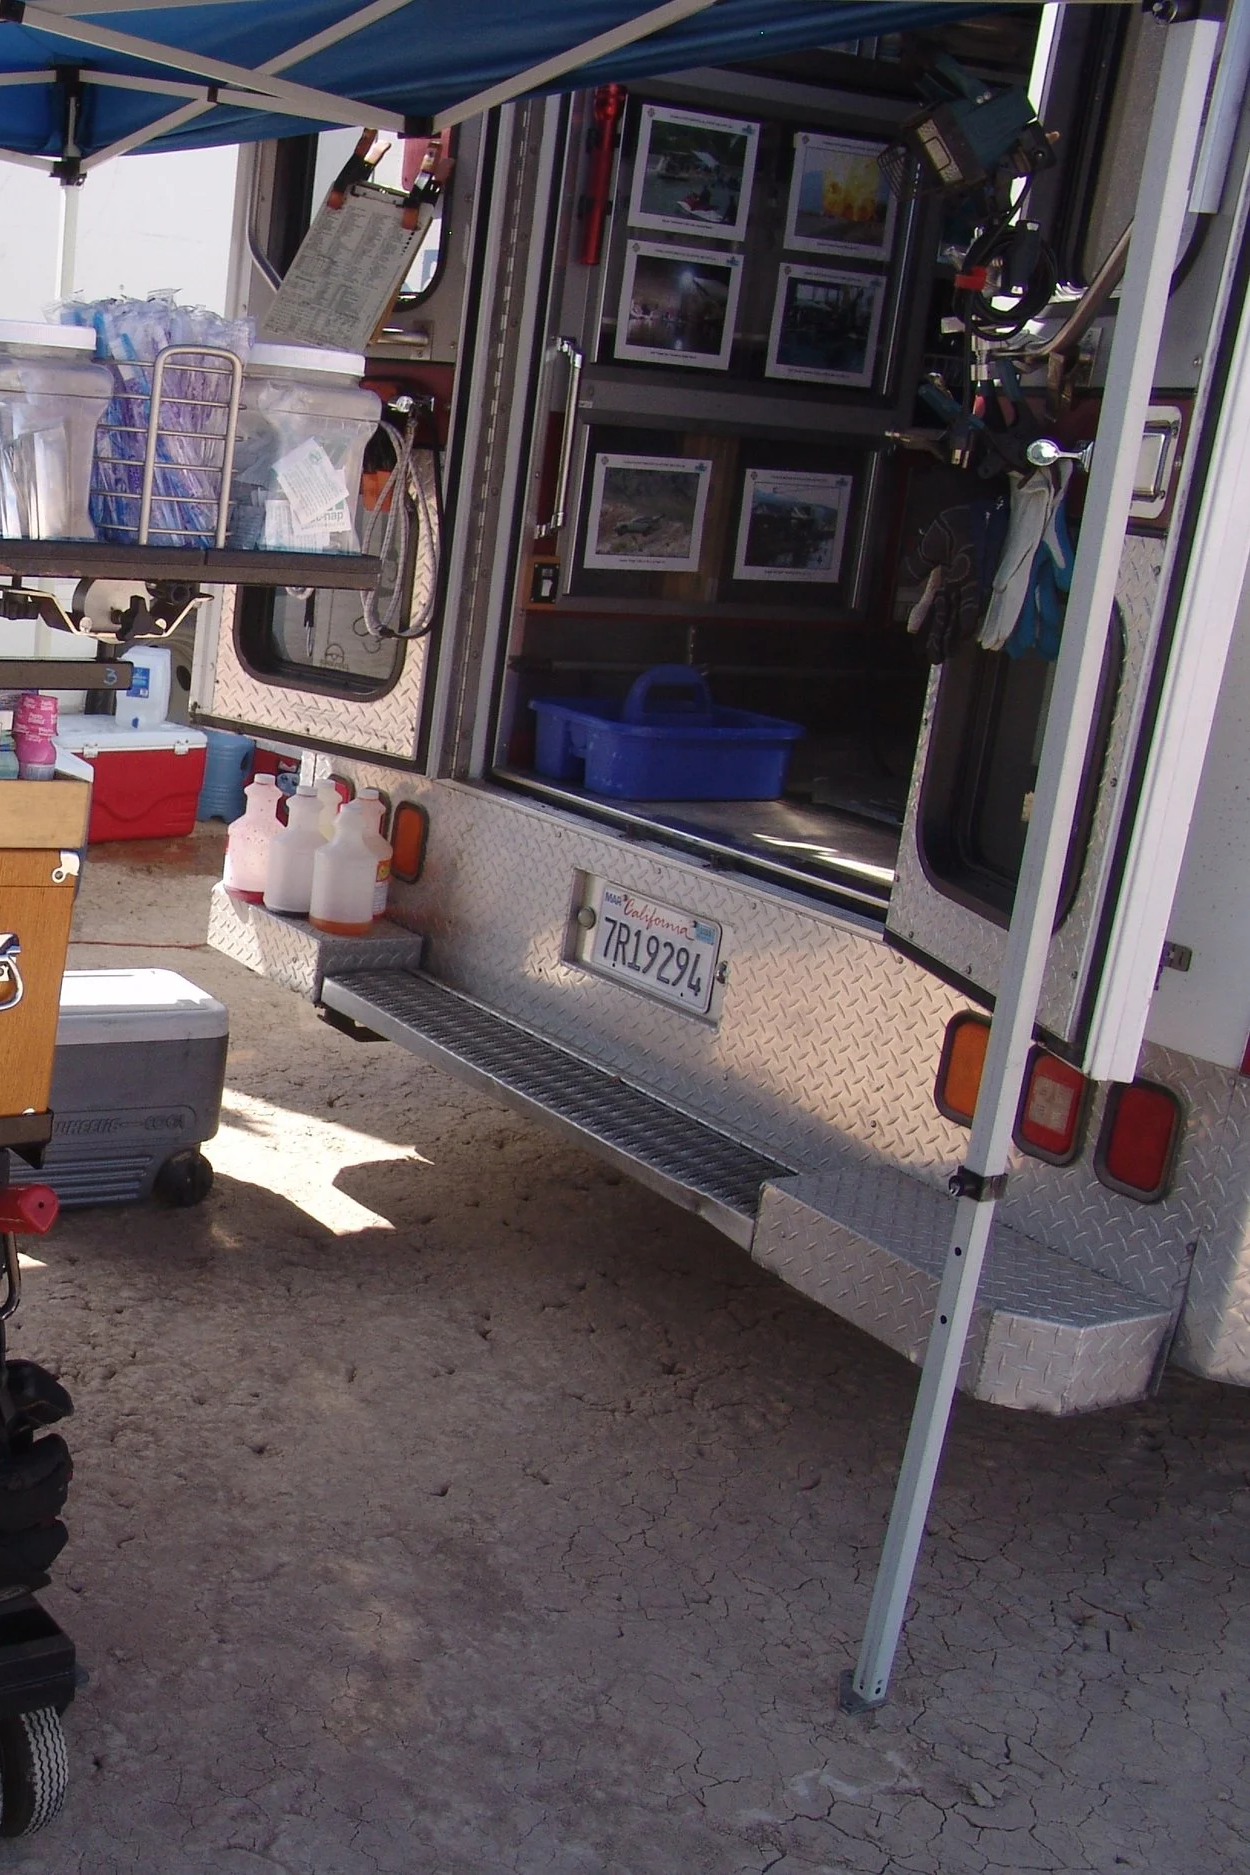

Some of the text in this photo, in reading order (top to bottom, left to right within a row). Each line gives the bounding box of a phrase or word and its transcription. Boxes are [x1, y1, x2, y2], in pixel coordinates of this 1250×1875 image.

[102, 667, 118, 686] 3
[605, 891, 622, 907] MAR
[623, 896, 695, 941] California
[603, 916, 702, 996] 7R19294
